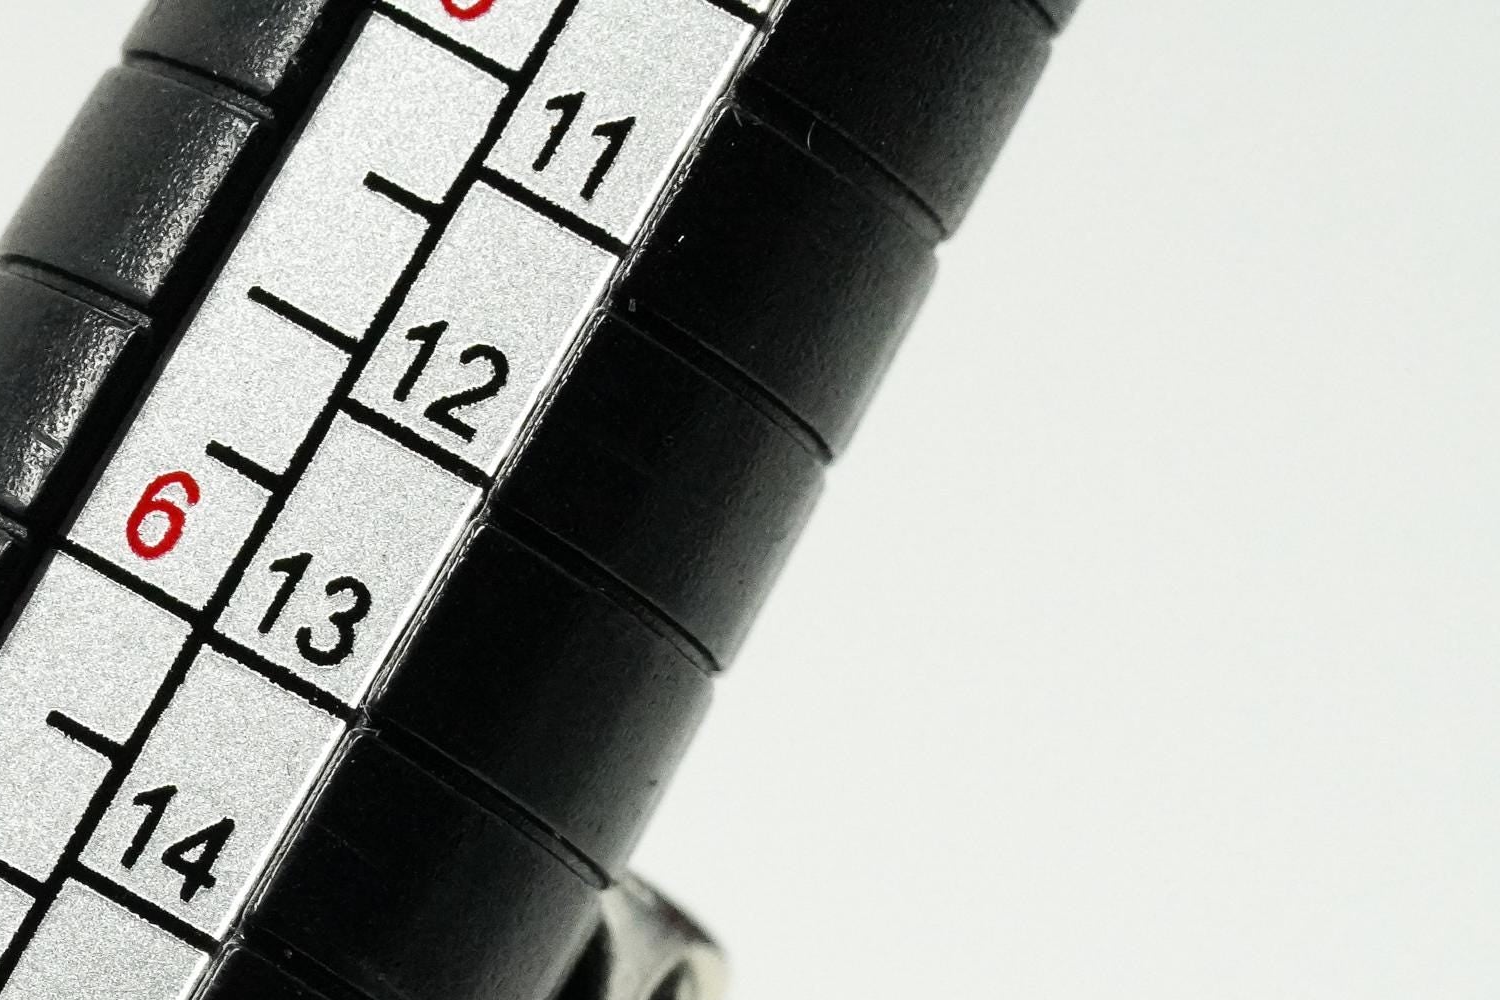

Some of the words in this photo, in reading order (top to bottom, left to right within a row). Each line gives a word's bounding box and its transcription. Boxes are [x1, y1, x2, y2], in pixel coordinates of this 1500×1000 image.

[532, 91, 635, 201] 11
[393, 320, 510, 443] 12
[125, 471, 201, 560] 6
[258, 553, 372, 666] 13
[120, 785, 235, 903] 14
